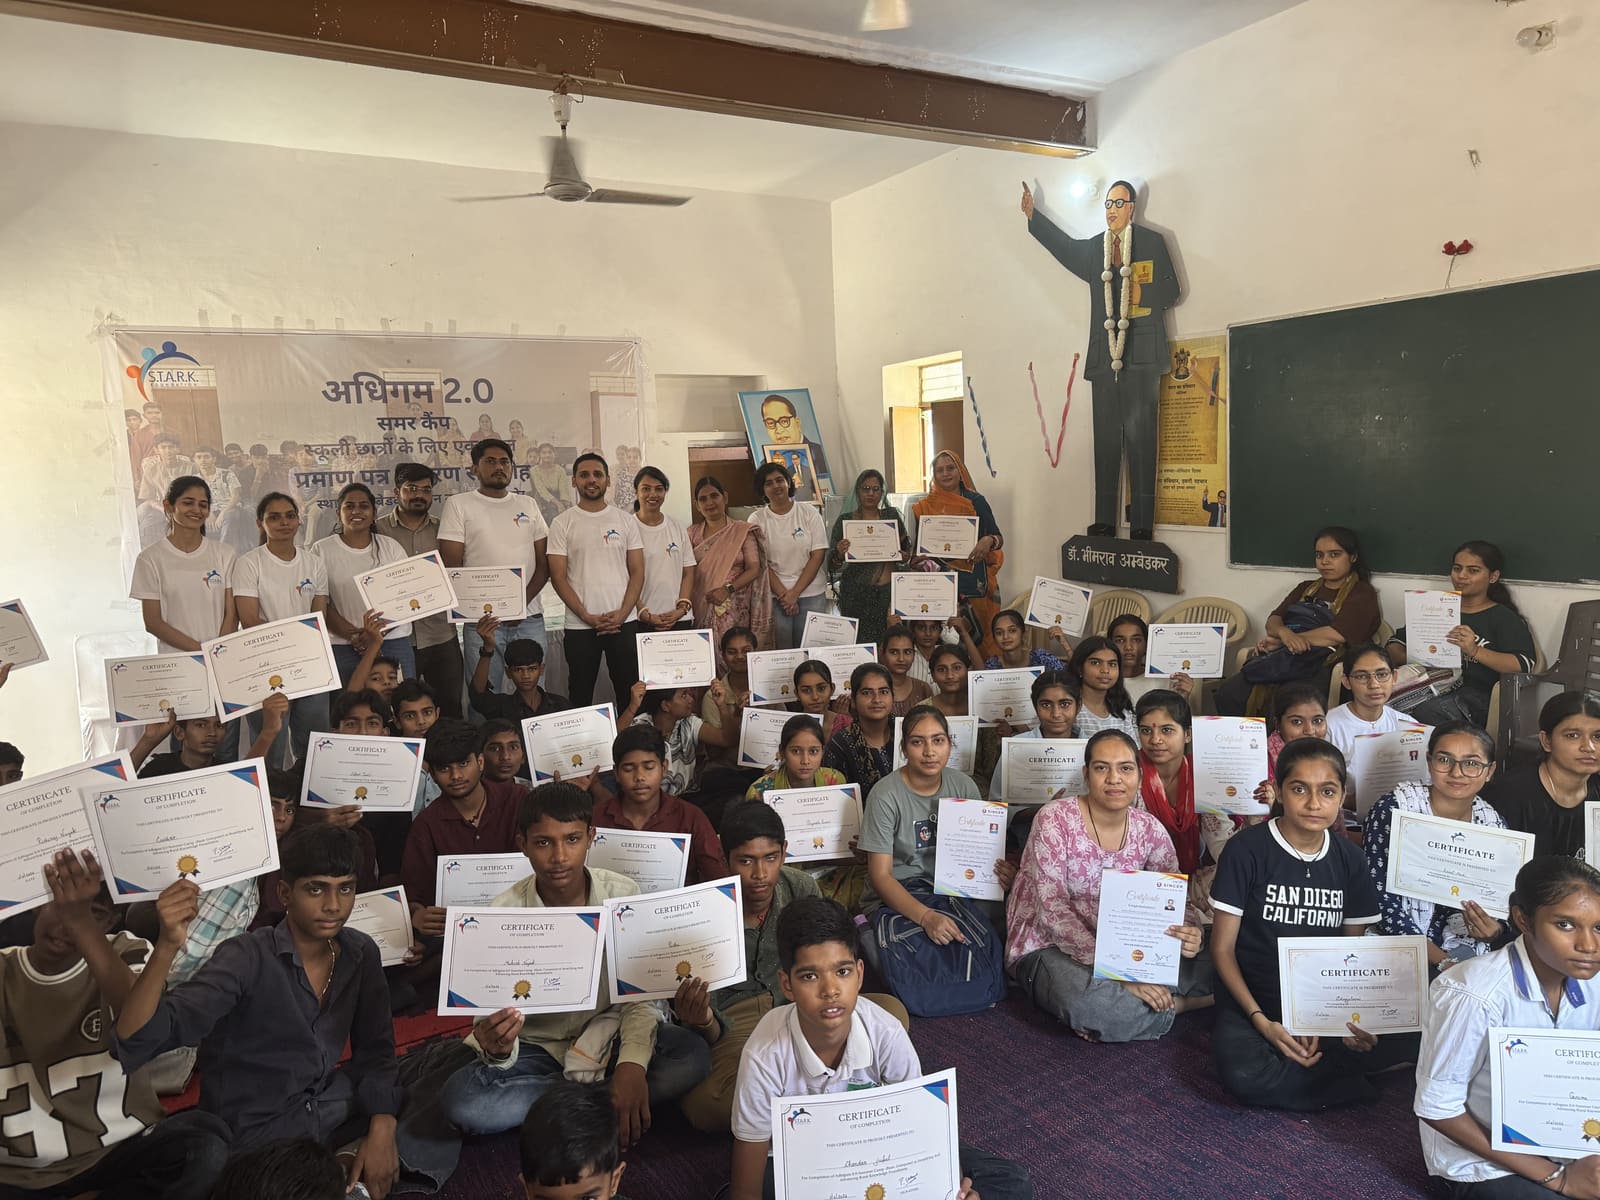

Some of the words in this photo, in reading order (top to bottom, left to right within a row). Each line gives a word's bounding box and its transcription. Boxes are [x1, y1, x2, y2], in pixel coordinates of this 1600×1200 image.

[148, 370, 199, 383] S.T.A.R.K.
[321, 372, 434, 404] अधिगम
[443, 377, 494, 404] 2.0
[376, 416, 416, 431] समर
[421, 411, 451, 431] कैंप
[304, 438, 350, 461] स्कूली
[355, 437, 396, 456] छात्रों
[398, 437, 414, 455] के
[418, 437, 449, 456] लिए
[294, 470, 355, 488] प्रमाण
[360, 469, 390, 485] पत्र
[1067, 546, 1080, 562] डॉ.
[1081, 546, 1117, 568] भीमराव
[1120, 551, 1170, 575] अम्बेडकर
[6, 786, 72, 812] CERTIFICATE
[144, 787, 207, 804] CERTIFICATE
[1427, 840, 1496, 860] CERTIFICATE
[475, 864, 514, 872] CERTIFICATE
[1265, 884, 1301, 906] SAN
[1303, 887, 1344, 909] DIEGO
[654, 900, 701, 915] CERTIFICATE
[500, 923, 555, 931] CERTIFICATE
[1320, 968, 1391, 977] CERTIFICATE
[838, 1105, 902, 1122] CERTIFICATE
